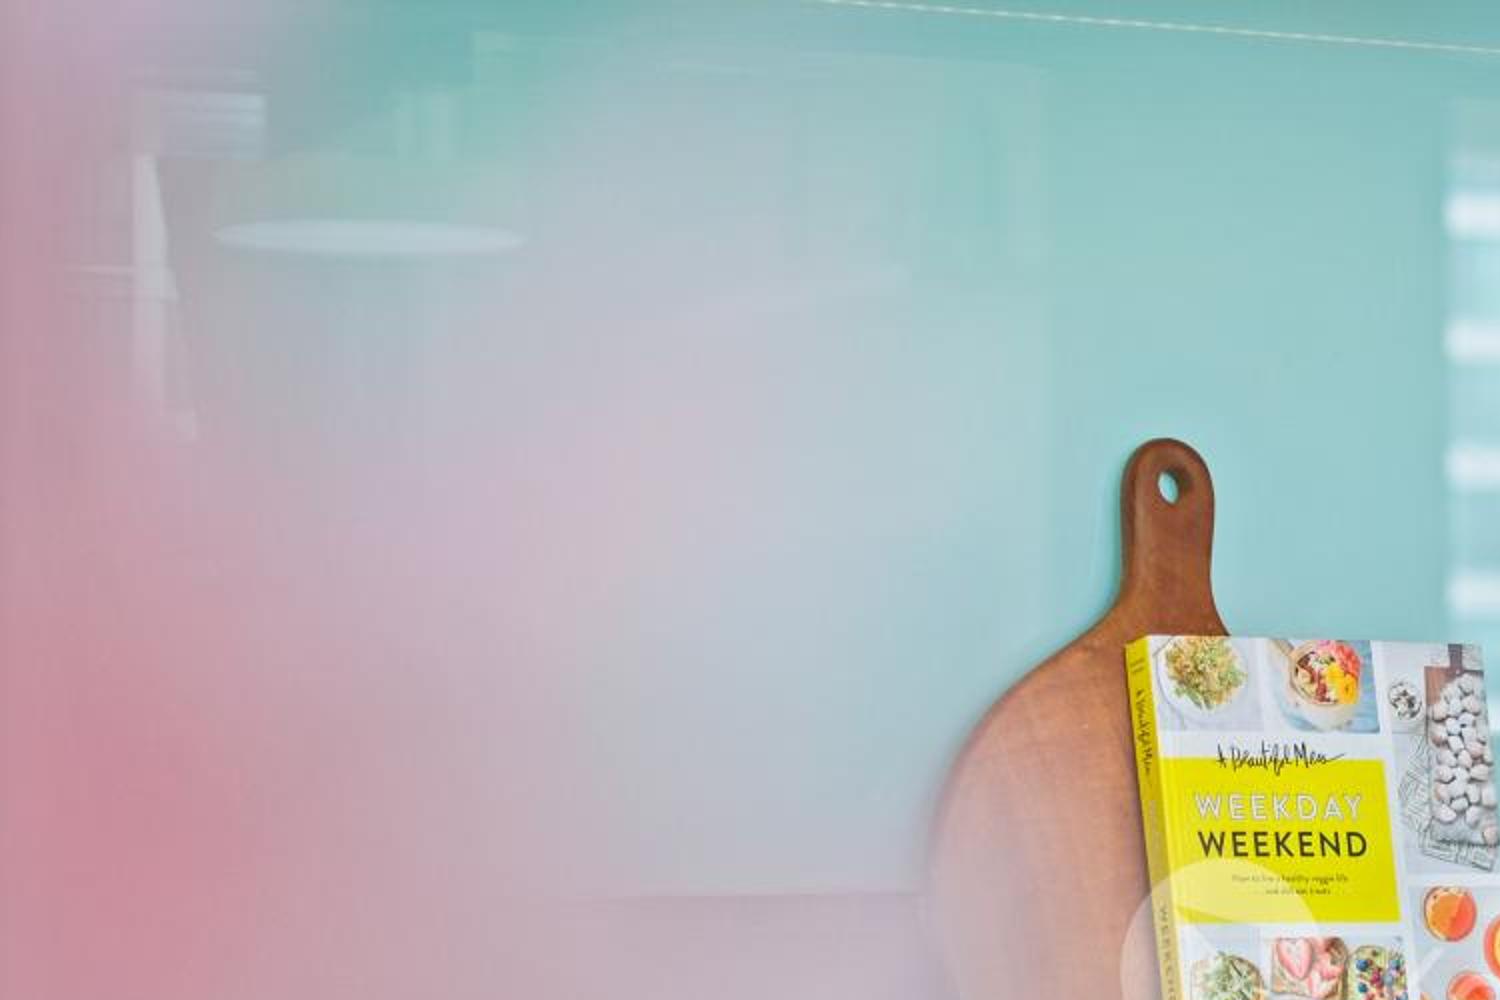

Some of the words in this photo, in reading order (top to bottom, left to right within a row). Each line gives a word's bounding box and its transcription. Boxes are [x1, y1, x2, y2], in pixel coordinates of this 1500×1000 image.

[1230, 740, 1293, 776] Beautiful
[1293, 741, 1346, 769] Mess
[1194, 792, 1364, 821] WEEKDAY
[1197, 830, 1368, 858] WEEKEND
